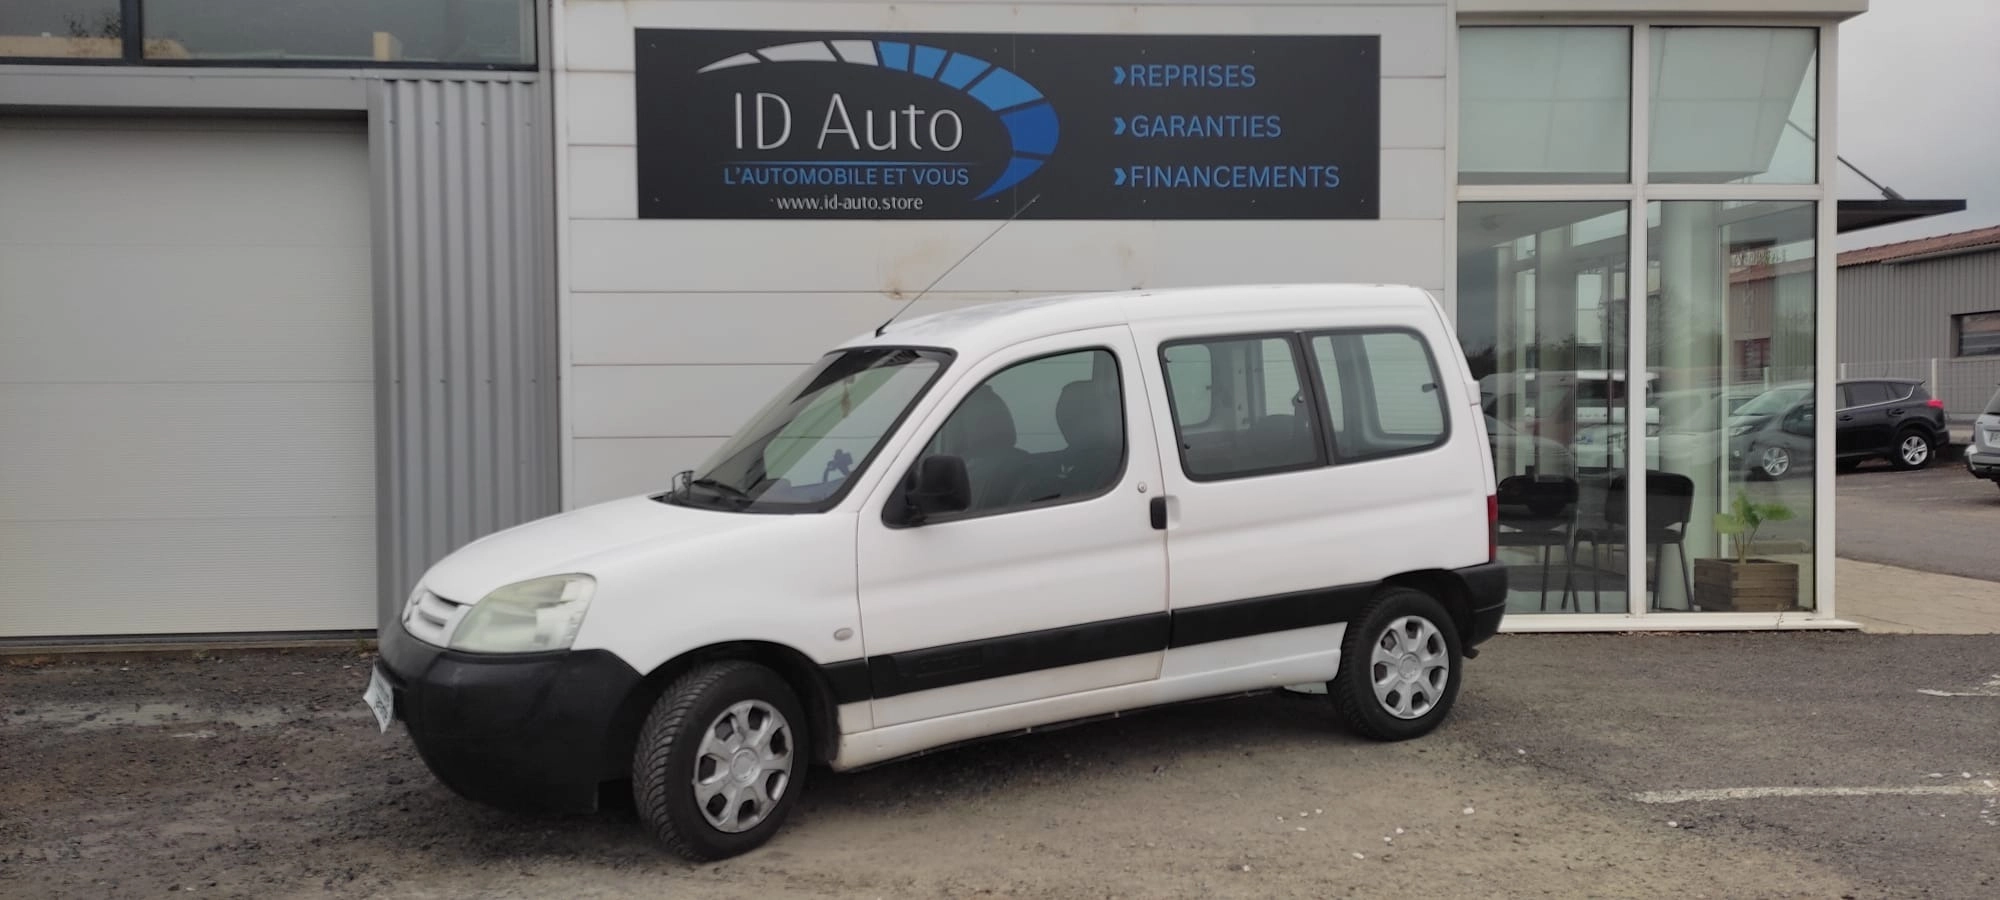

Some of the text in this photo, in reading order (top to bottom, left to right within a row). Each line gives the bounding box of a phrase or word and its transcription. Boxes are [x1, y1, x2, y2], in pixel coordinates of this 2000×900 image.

[1130, 64, 1256, 87] REPRISES
[735, 92, 963, 151] ID Auto
[1131, 115, 1282, 138] GARANTIES
[723, 167, 970, 186] L'AUTOMOBILE ET VOUS
[1130, 166, 1341, 188] FINANCEMENTS
[776, 194, 924, 210] www.id-auto.store
